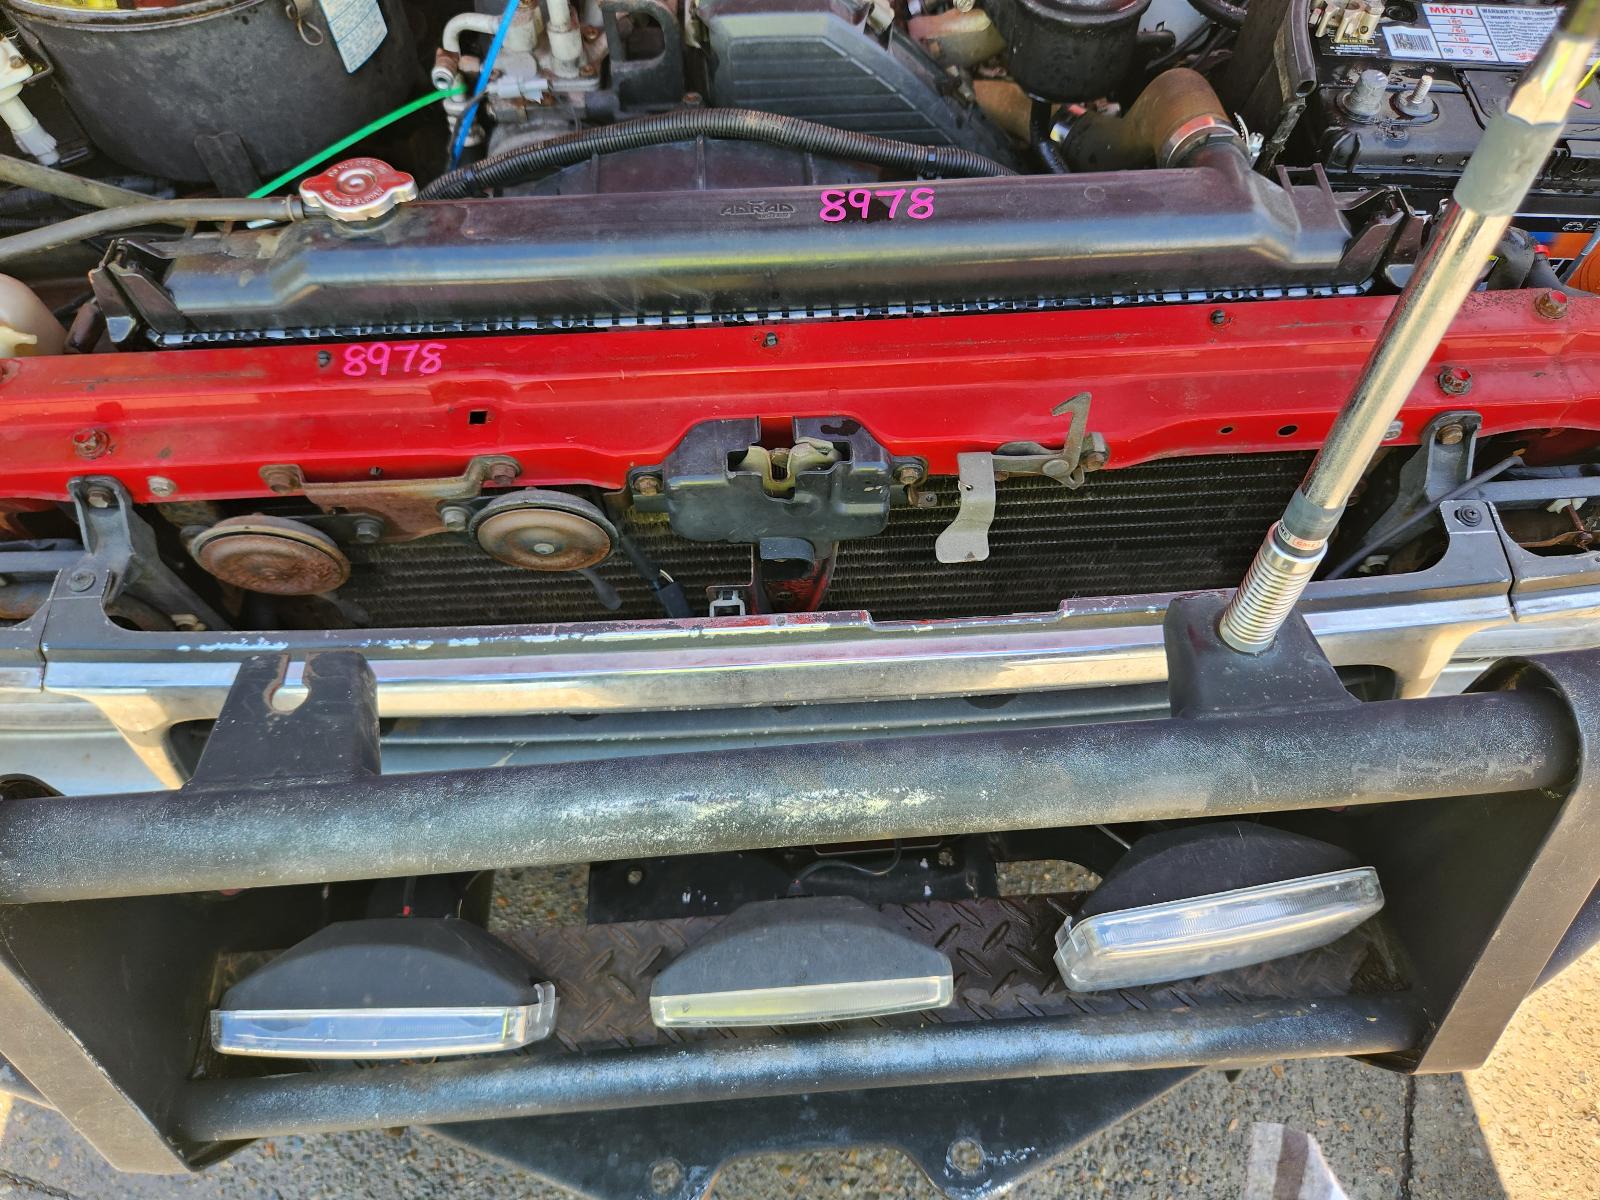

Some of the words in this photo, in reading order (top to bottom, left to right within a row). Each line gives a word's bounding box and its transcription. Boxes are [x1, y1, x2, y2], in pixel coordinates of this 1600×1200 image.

[1429, 6, 1473, 16] MRV70
[819, 187, 935, 222] 8978
[343, 341, 447, 376] 8978
